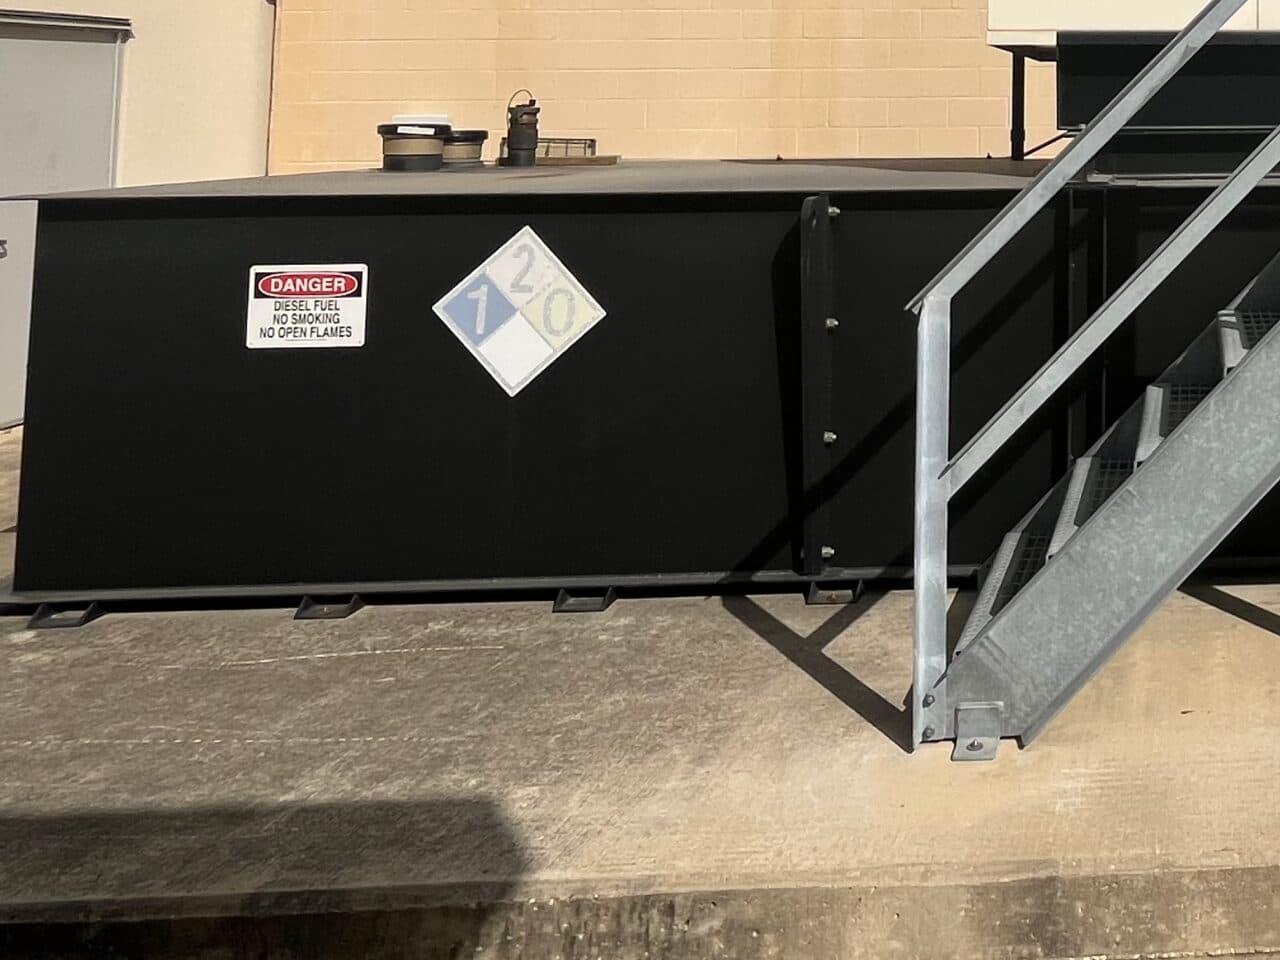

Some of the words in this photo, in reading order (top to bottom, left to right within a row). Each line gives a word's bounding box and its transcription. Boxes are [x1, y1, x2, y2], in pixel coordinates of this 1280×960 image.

[510, 243, 536, 293] 2
[270, 277, 346, 293] DANGER
[274, 300, 311, 311] DIESEL
[313, 299, 341, 311] FUEL
[467, 284, 488, 335] 1
[543, 288, 576, 337] 0
[272, 313, 289, 325] NO
[291, 312, 341, 325] SMOKING
[259, 327, 275, 338] NO
[277, 326, 307, 338] OPEN
[309, 326, 352, 338] FLAMES
